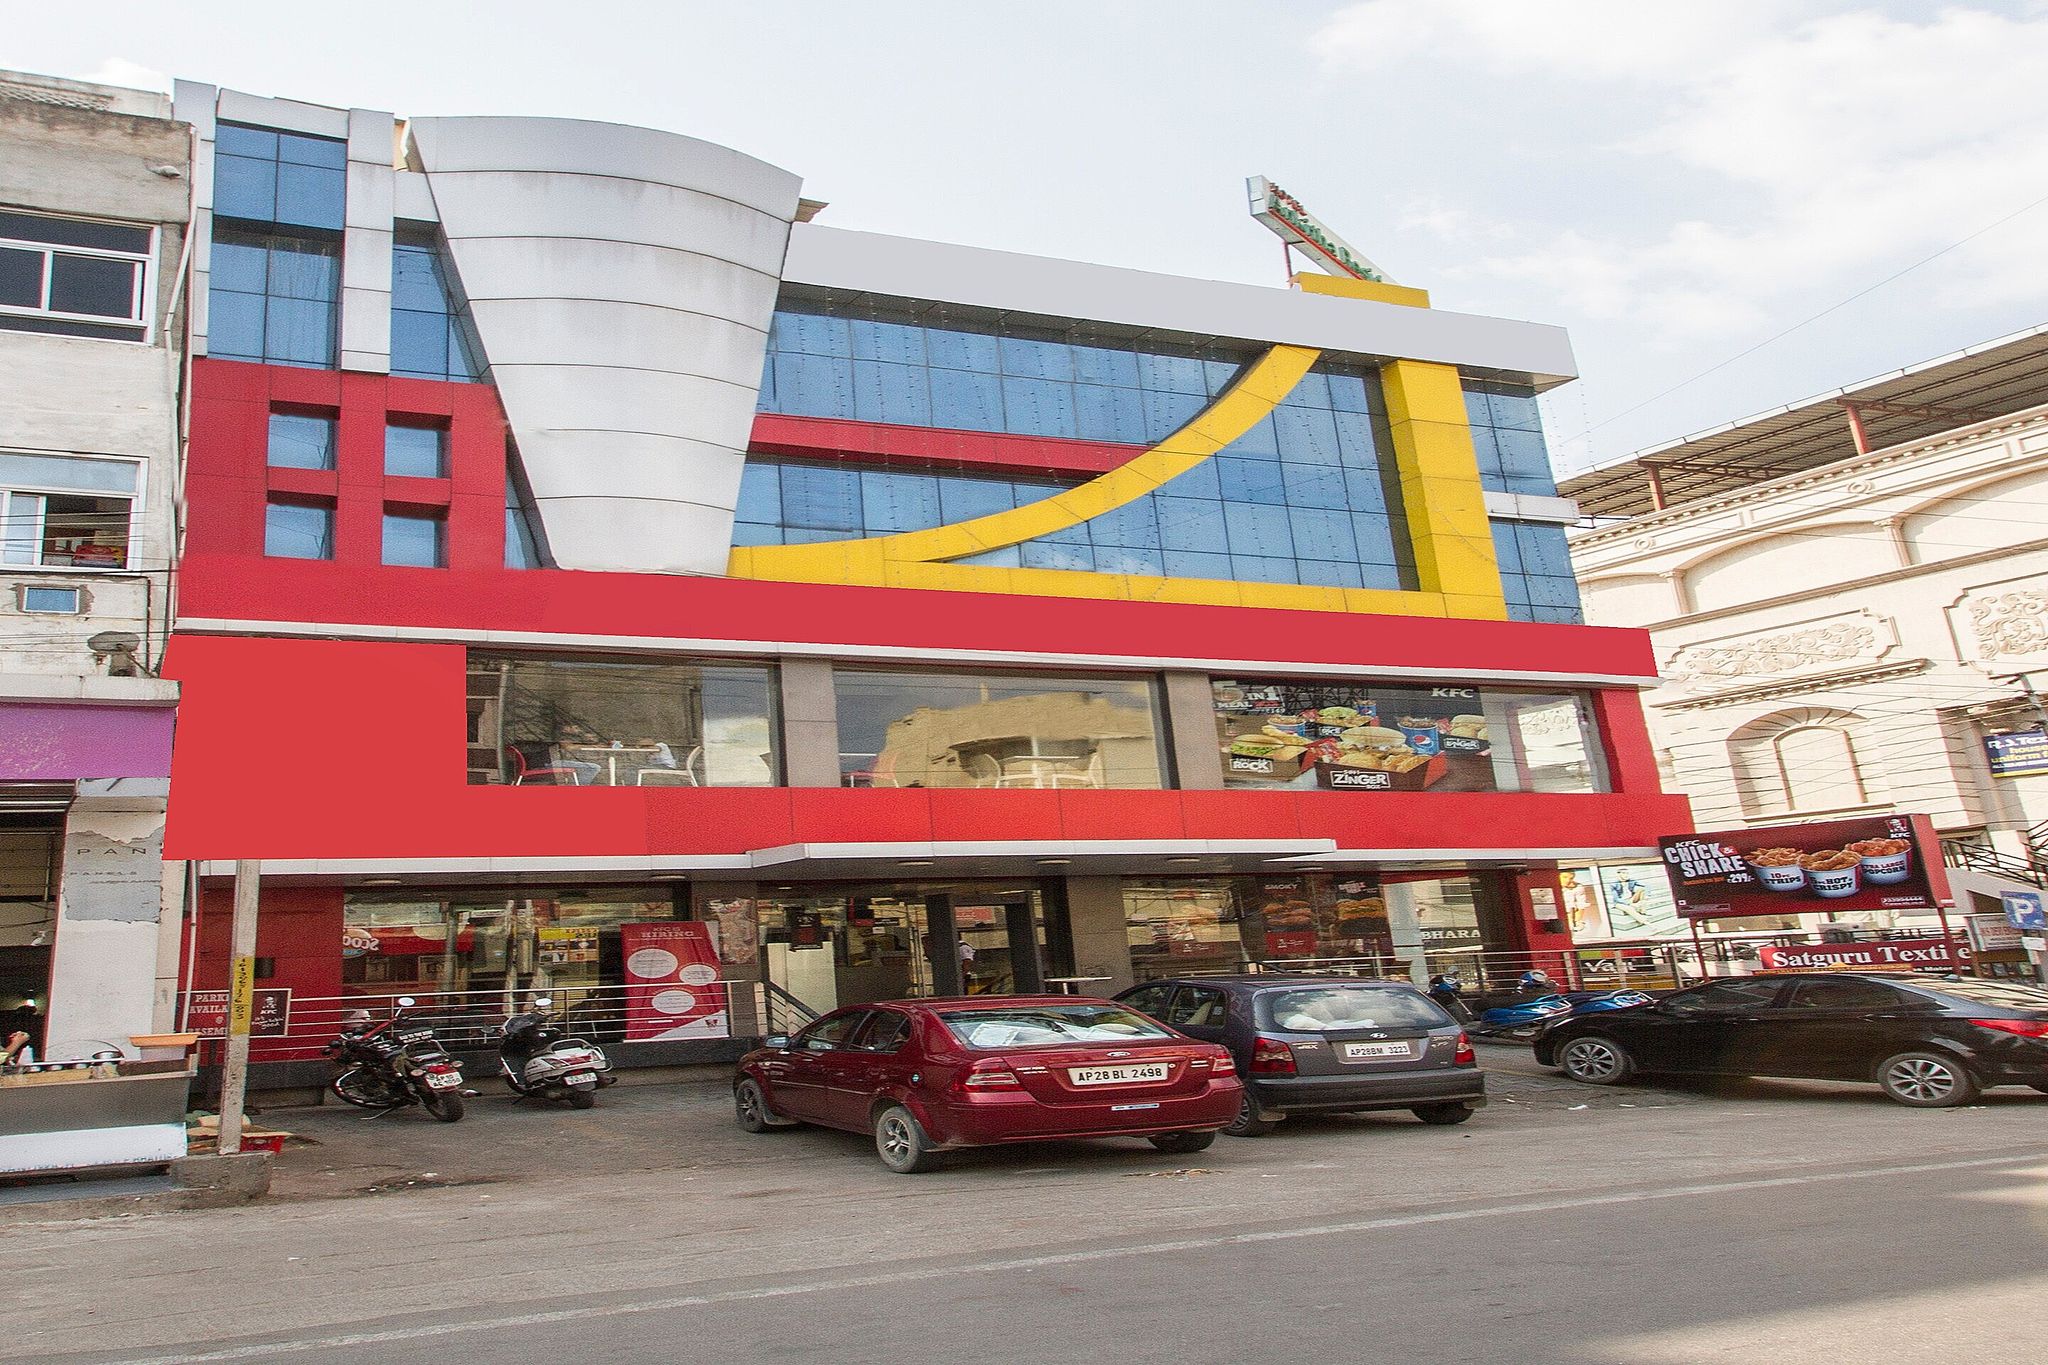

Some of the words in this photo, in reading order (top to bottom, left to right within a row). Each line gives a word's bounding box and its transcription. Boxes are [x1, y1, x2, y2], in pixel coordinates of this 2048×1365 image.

[1431, 687, 1475, 698] KFC
[1232, 760, 1269, 770] ROCK
[1333, 774, 1387, 785] ZINGER
[1675, 840, 1700, 848] KFC
[1664, 843, 1722, 864] CHICK
[1680, 856, 1746, 877] SHARE
[1862, 866, 1906, 874] POPCORN
[1764, 876, 1802, 885] STRIPS
[2005, 897, 2033, 924] P
[1771, 947, 1871, 969] Satguru
[215, 1016, 224, 1024] @
[1350, 1047, 1384, 1056] AP28BM
[1078, 1069, 1110, 1082] AP28
[1113, 1069, 1127, 1080] BL
[1132, 1067, 1163, 1078] 2498
